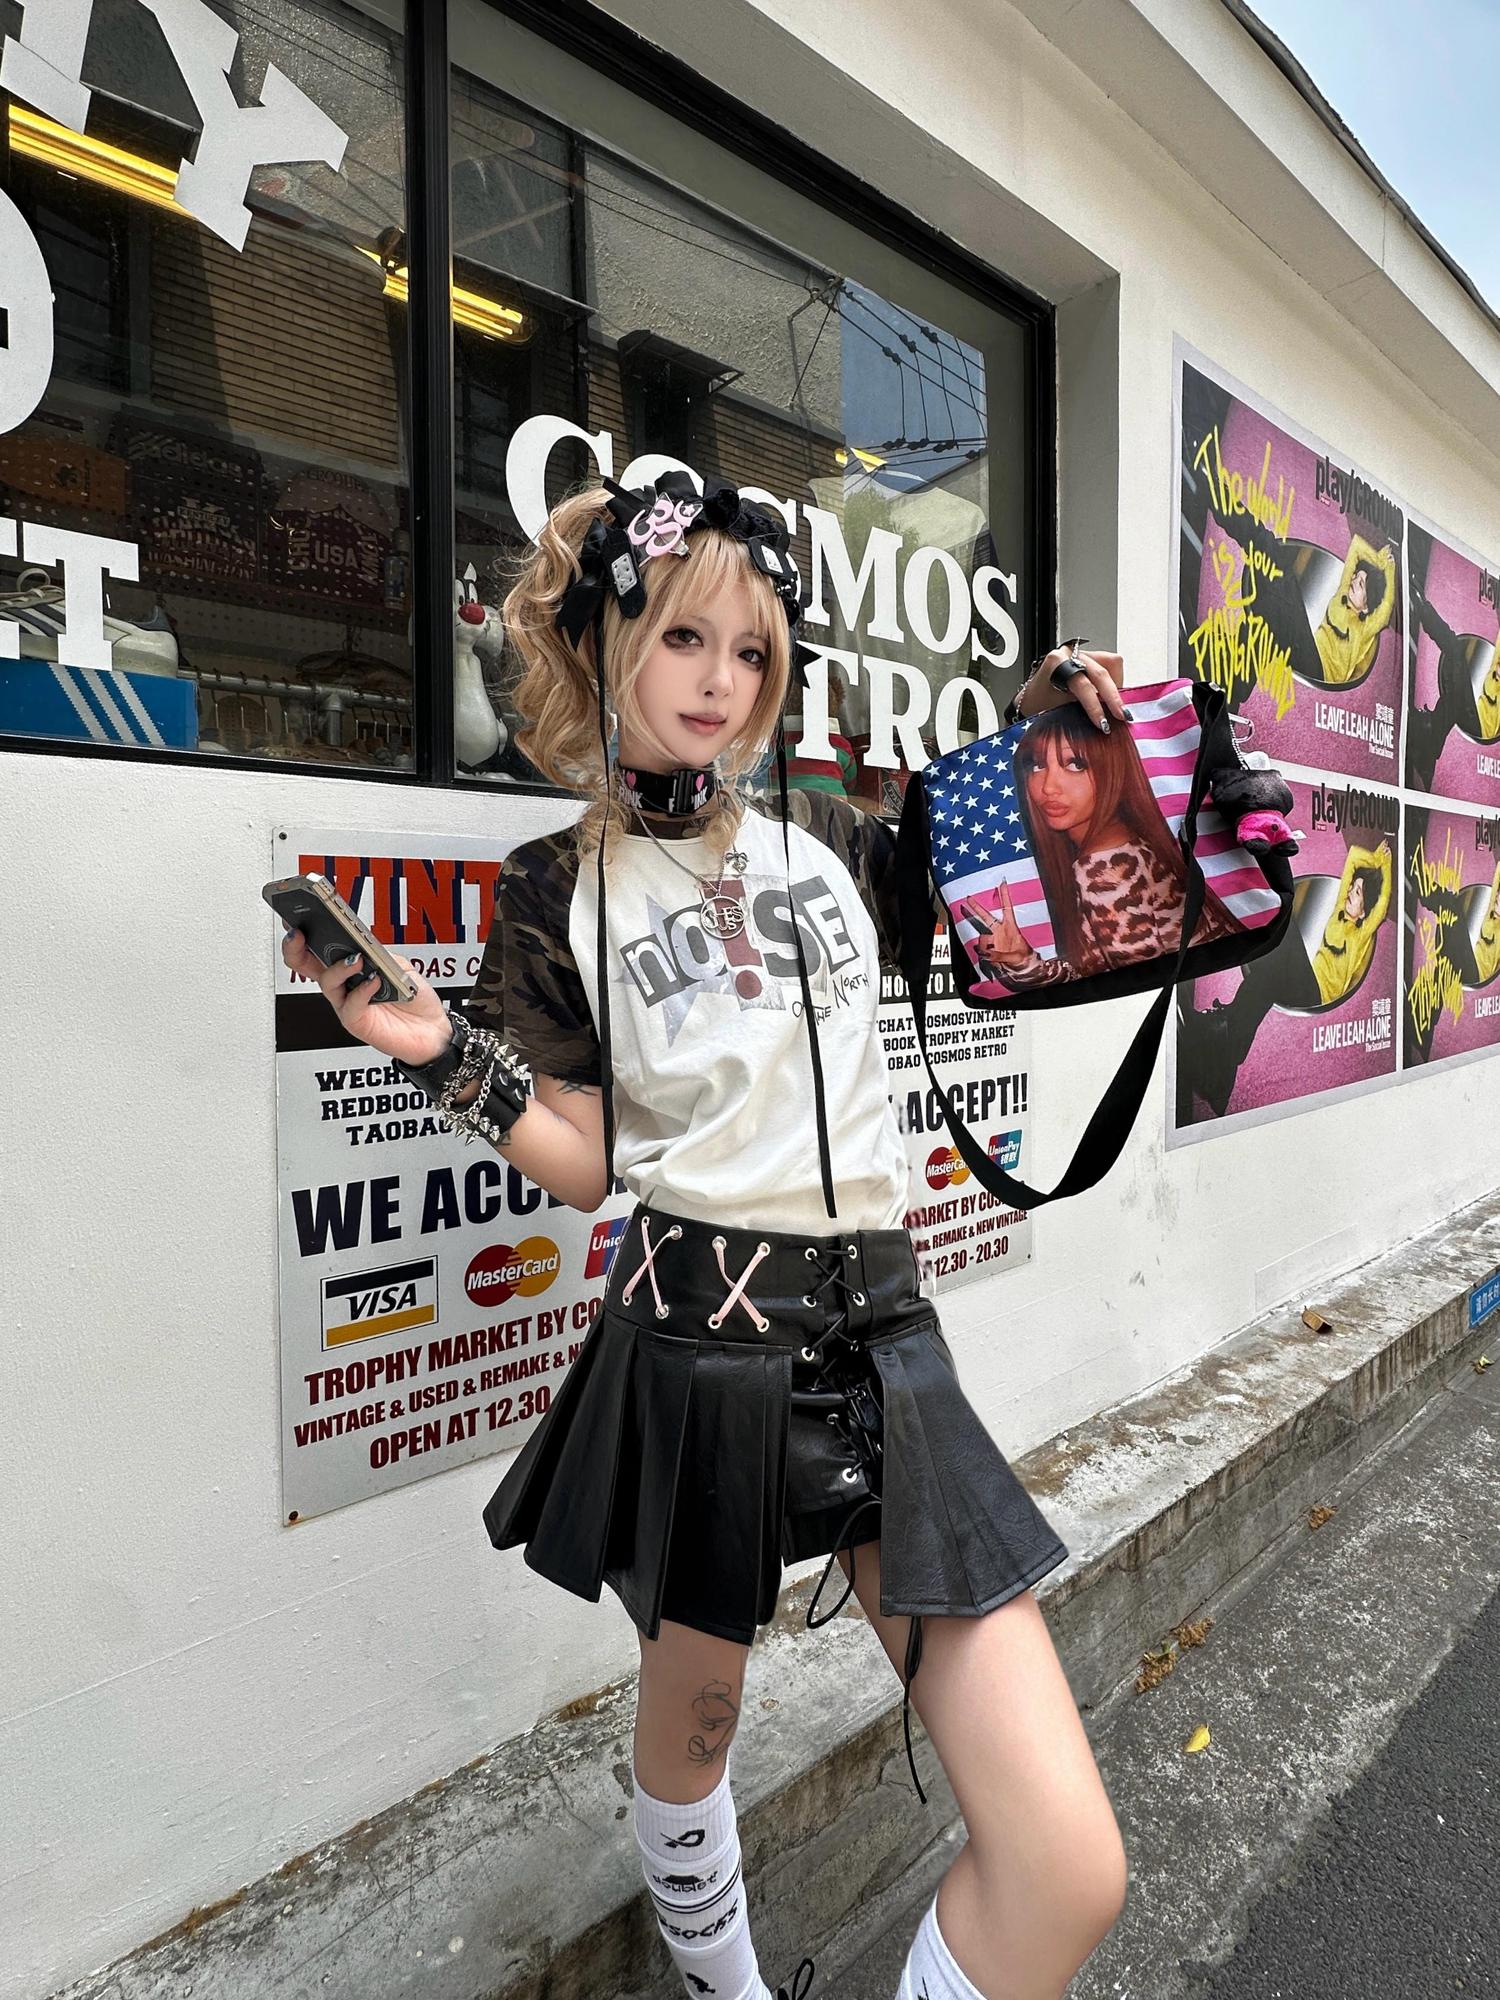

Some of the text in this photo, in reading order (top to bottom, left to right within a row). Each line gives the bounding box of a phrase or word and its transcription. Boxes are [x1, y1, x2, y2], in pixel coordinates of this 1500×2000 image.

[506, 415, 1018, 668] CMOS
[1315, 701, 1345, 734] LEAVE
[1345, 710, 1369, 741] LEAH
[1368, 718, 1394, 749] ALONE
[832, 972, 870, 1009] NORTH
[877, 1009, 1017, 1033] CHAT OSMOSVINTAGE4
[883, 1036, 916, 1052] BOOK
[971, 1025, 1015, 1042] MARKET
[1313, 1014, 1391, 1053] LEAVE LEAH ALONE
[887, 1043, 1007, 1070] OBAO COSMOS RETRO
[988, 1140, 1020, 1156] UnionPay
[291, 1160, 568, 1257] WE ACC
[961, 1194, 977, 1217] BY
[932, 1226, 967, 1249] REMAKE
[968, 1225, 975, 1238] &
[976, 1214, 995, 1235] NEW
[996, 1209, 1028, 1230] VINTAGE
[467, 1253, 559, 1292] MasterCard
[934, 1249, 967, 1278] 12.30
[976, 1235, 1009, 1264] 20.30
[346, 1283, 418, 1321] VISA
[304, 1346, 422, 1406] TROPHY
[428, 1317, 532, 1372] MARKET
[537, 1306, 568, 1341] BY
[294, 1401, 386, 1447] VINTAGE
[390, 1399, 405, 1419] &
[409, 1379, 458, 1412] USED
[463, 1378, 477, 1397] &
[480, 1352, 550, 1392] REMAKE
[553, 1351, 566, 1369] &
[370, 1385, 551, 1469] OPEN AT 12.30
